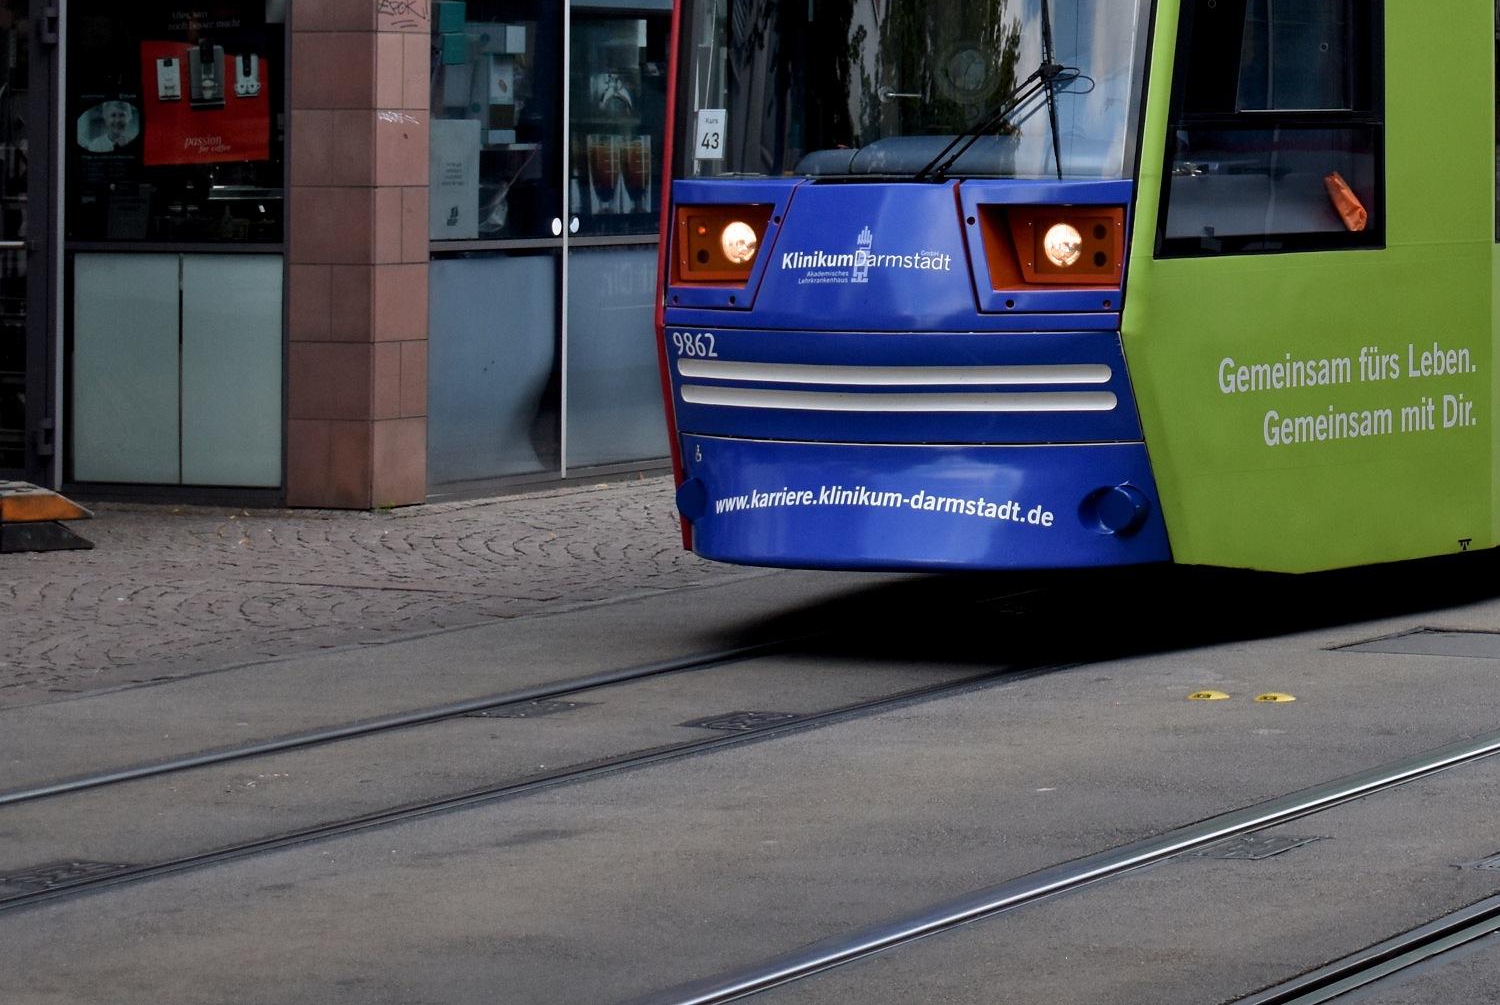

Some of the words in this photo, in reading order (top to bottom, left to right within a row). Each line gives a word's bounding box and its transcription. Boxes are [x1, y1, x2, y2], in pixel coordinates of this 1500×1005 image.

[705, 117, 719, 125] Kurs
[184, 135, 222, 149] passion
[701, 132, 719, 150] 43
[916, 249, 939, 258] GmbH
[798, 277, 848, 286] Lehrkrankenhaus
[807, 270, 849, 279] Akademisches
[673, 332, 718, 357] 9862
[1218, 353, 1351, 394] Gemeinsam
[1358, 346, 1400, 382] fürs
[1408, 342, 1476, 377] Leben.
[1263, 404, 1392, 446] Gemeinsam
[1401, 397, 1435, 432] mit
[1443, 393, 1476, 428] Dir.
[715, 485, 1054, 527] www.karriere.klinikum-darmstadt.de
